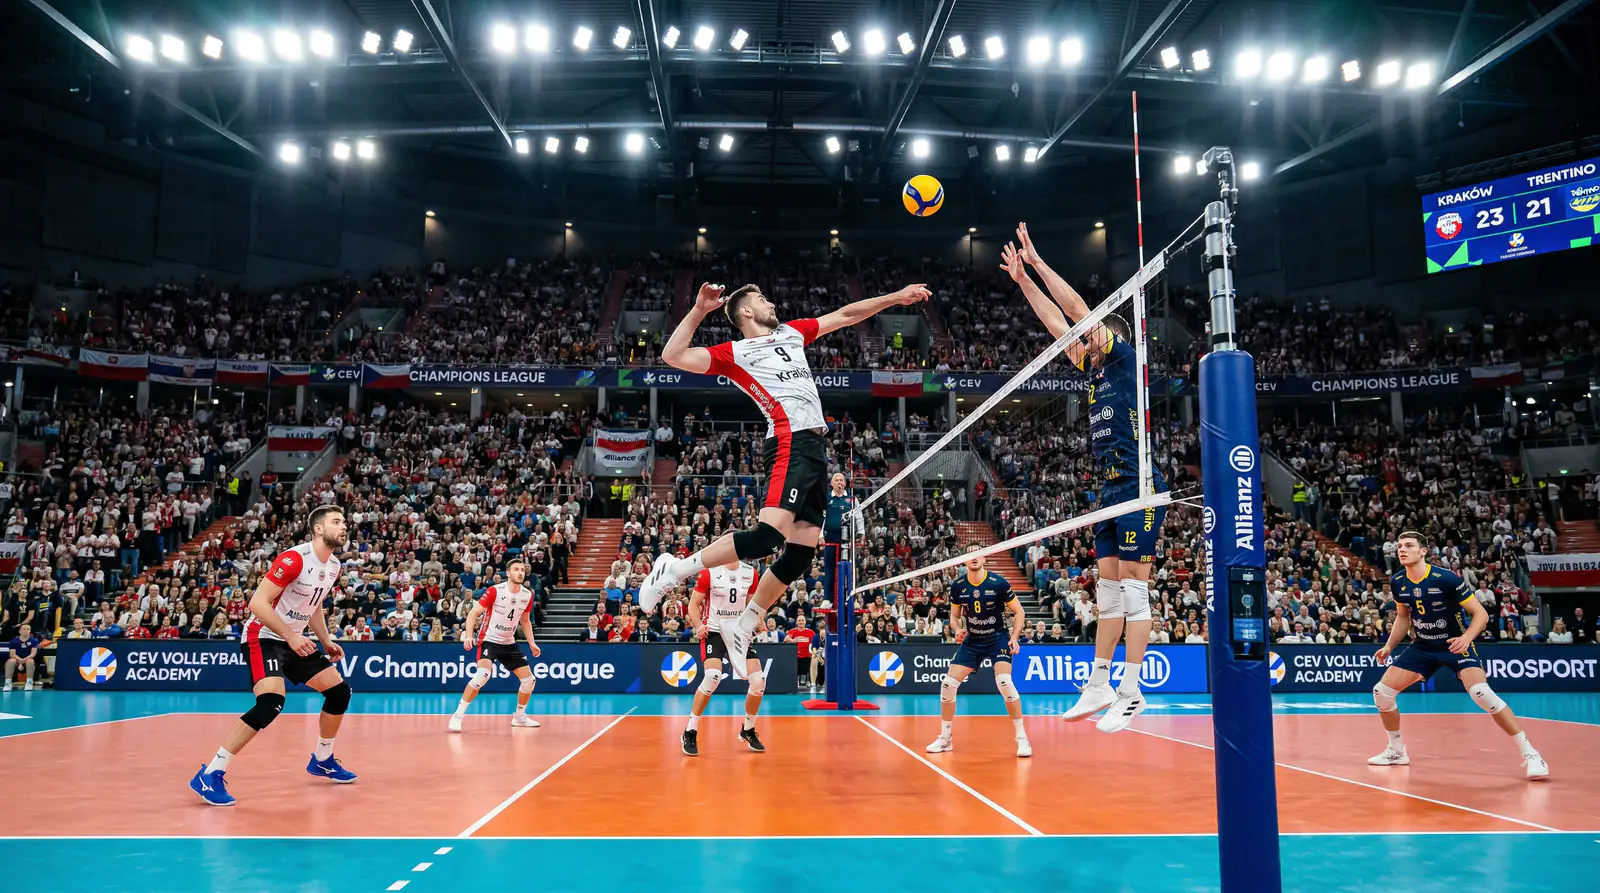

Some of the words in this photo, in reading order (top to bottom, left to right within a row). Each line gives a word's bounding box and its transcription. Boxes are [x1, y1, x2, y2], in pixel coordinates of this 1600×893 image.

[1527, 163, 1596, 187] TRENTINO
[1438, 185, 1494, 207] KRAKÓW
[1526, 197, 1551, 219] 21
[1476, 206, 1504, 229] 23
[774, 346, 792, 362] 9
[338, 370, 361, 379] CEV
[409, 370, 490, 382] CHAMPIONS
[494, 371, 546, 383] LEAGUE
[658, 374, 681, 383] CEV
[814, 376, 849, 387] AGUE
[959, 379, 982, 388] CEV
[1017, 379, 1090, 391] HAMPIONS
[1255, 382, 1277, 391] CEV
[1312, 377, 1398, 392] CHAMPIONS
[1401, 372, 1459, 388] LEAGUE
[788, 487, 799, 504] 9
[1234, 477, 1254, 551] Allianz
[1125, 531, 1137, 544] 12
[1205, 538, 1215, 613] Allianz
[309, 586, 324, 607] 11
[729, 587, 737, 604] 8
[974, 600, 982, 613] 8
[1415, 600, 1426, 615] 5
[507, 608, 515, 622] 4
[482, 648, 489, 656] 4
[706, 644, 713, 654] 8
[127, 652, 160, 665] CEV
[161, 652, 247, 666] VOLLEYBAL
[267, 658, 279, 671] 11
[1293, 655, 1323, 668] CEV
[125, 668, 202, 681] ACADEMY
[533, 660, 615, 684] eague
[1025, 655, 1126, 681] Alliaz
[1294, 670, 1363, 683] ACADEMY
